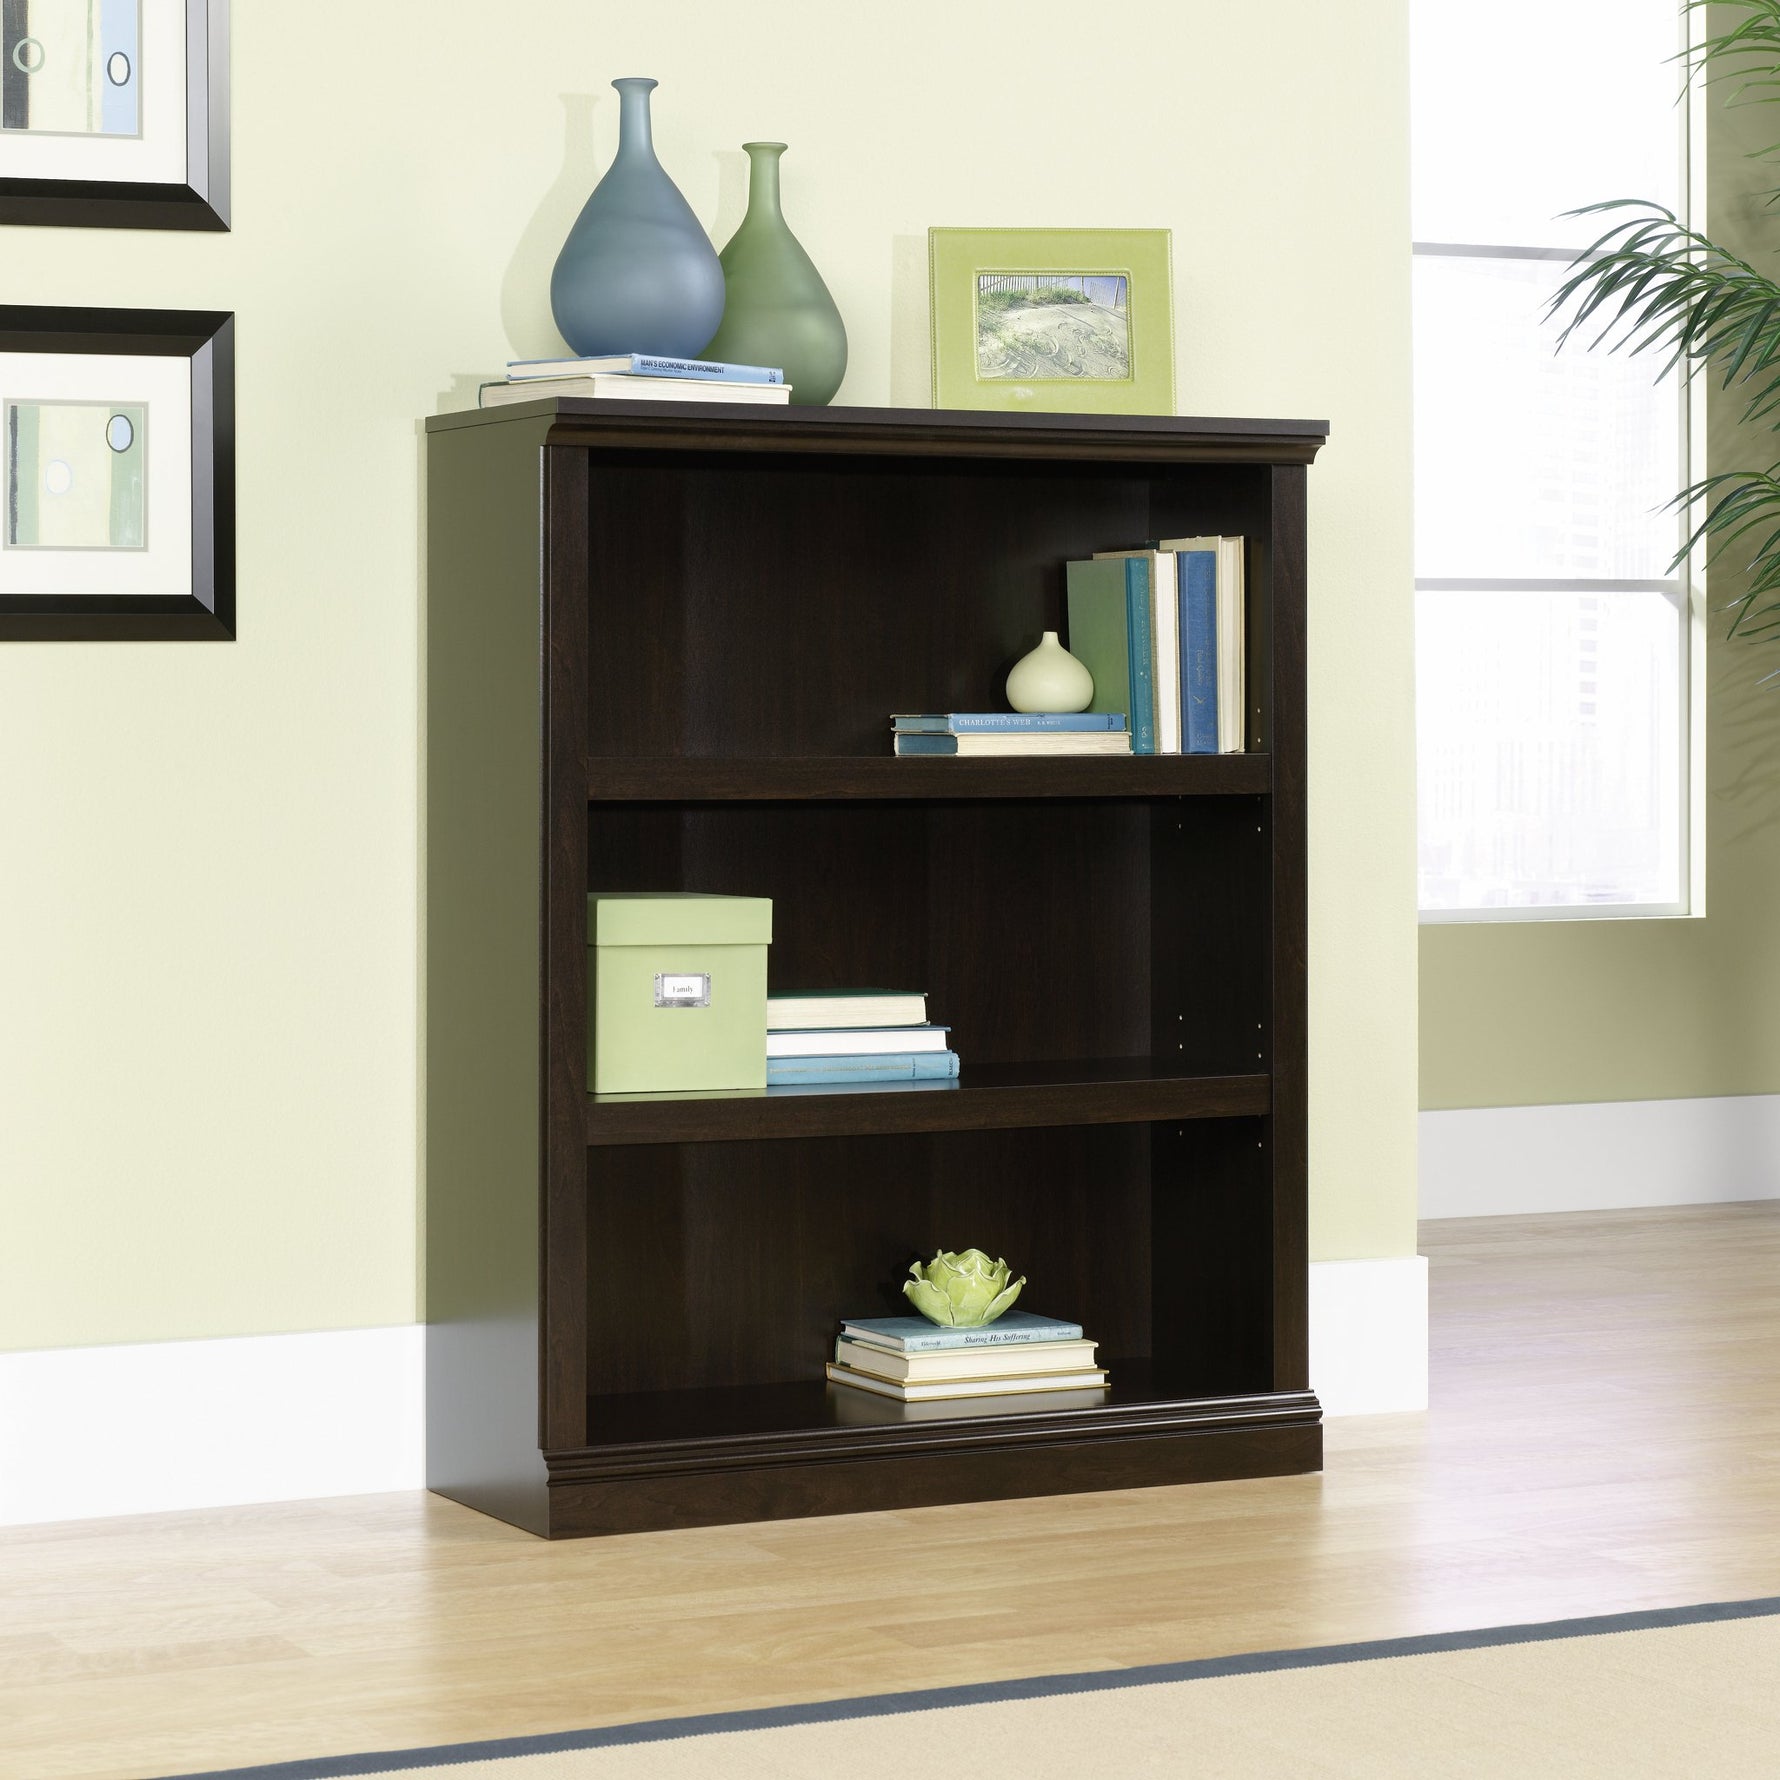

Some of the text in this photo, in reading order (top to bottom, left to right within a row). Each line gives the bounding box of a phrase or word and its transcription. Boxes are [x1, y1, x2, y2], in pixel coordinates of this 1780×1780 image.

[640, 359, 658, 367] MAN'S
[658, 360, 687, 371] ECONOMIC
[687, 363, 725, 374] ENVIRONMENT
[1012, 718, 1031, 726] WEB
[672, 985, 694, 994] Family
[963, 1332, 1031, 1345] Sharing His Suffering
